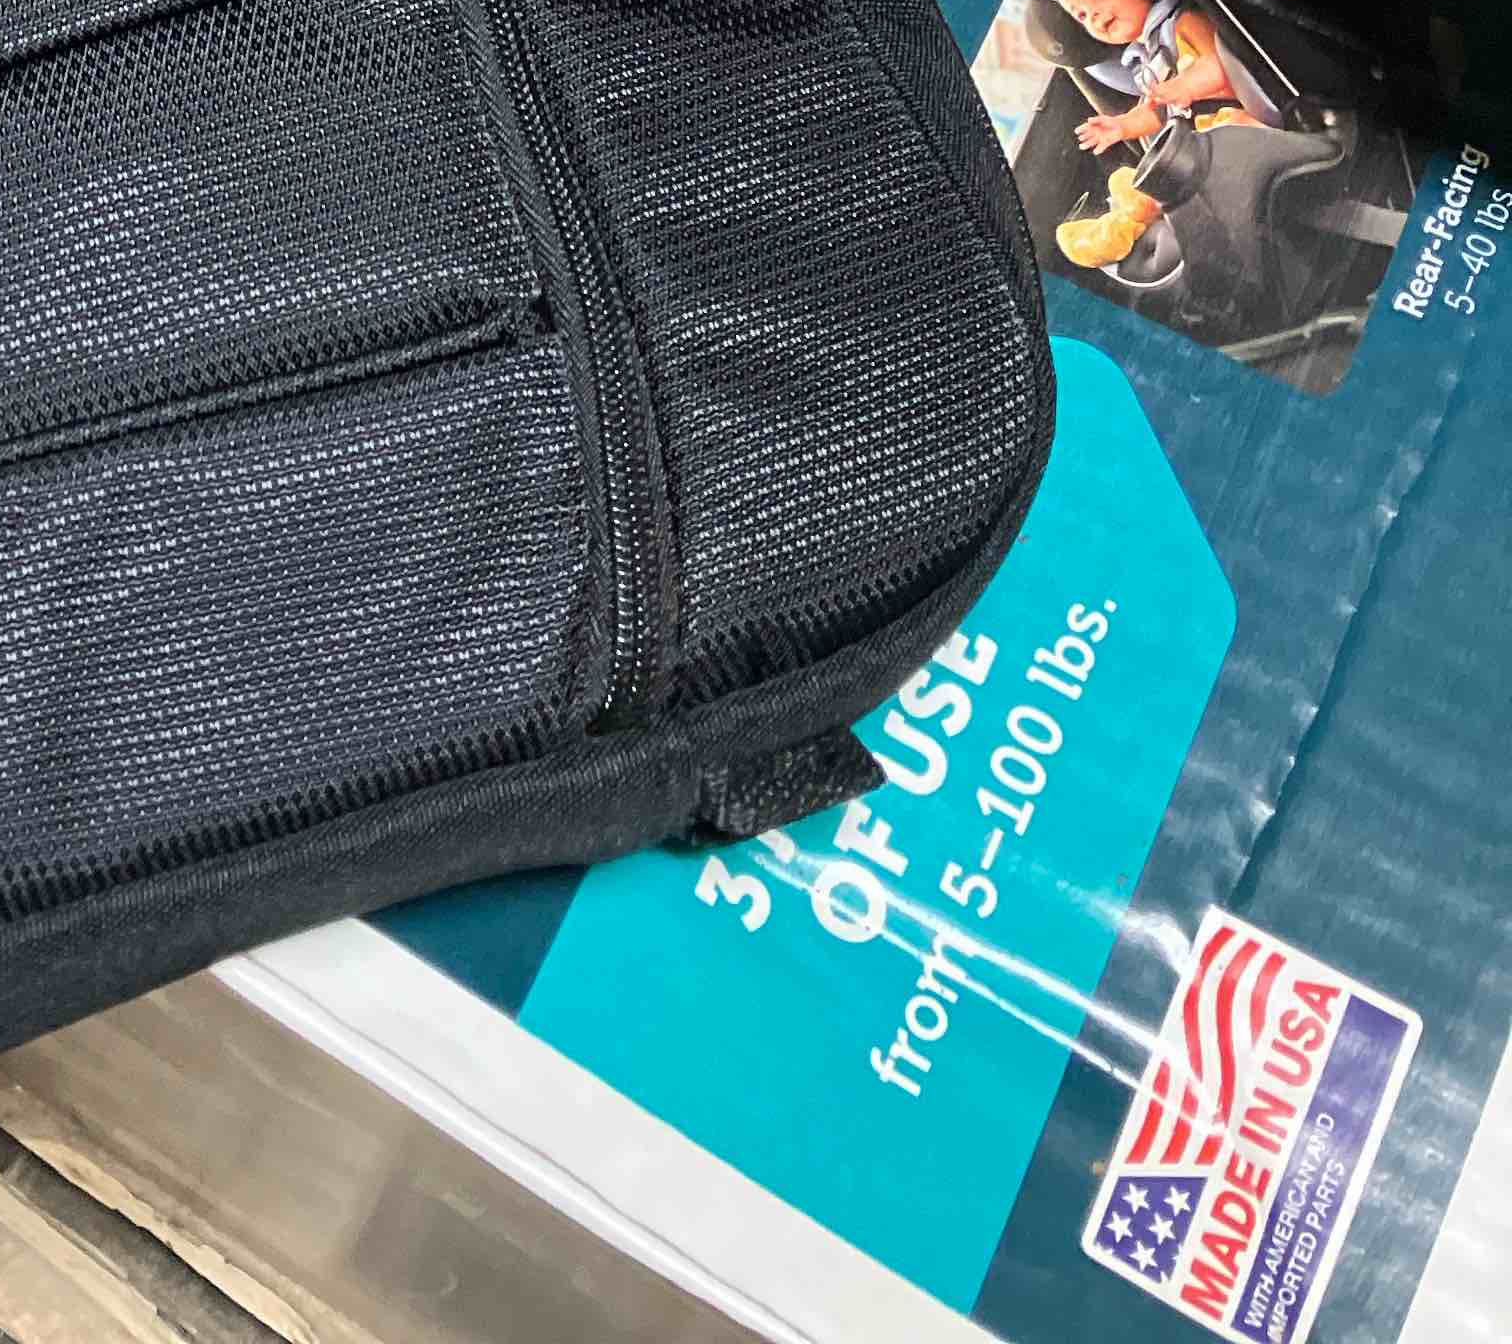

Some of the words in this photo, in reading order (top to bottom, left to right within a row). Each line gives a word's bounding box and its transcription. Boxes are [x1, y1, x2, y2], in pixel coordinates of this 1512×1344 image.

[1393, 143, 1489, 320] Rear-Facing
[875, 630, 999, 797] USE
[870, 924, 979, 1098] from
[1026, 598, 1119, 701] lbs.
[1238, 1086, 1299, 1155] IN
[1262, 980, 1342, 1087] USA
[1180, 1150, 1272, 1322] MADE
[1243, 1273, 1276, 1329] WITH
[1267, 1160, 1317, 1284] AMERICAN
[1305, 1112, 1336, 1168] AND
[1266, 1231, 1317, 1342] IMPORTED
[1305, 1158, 1346, 1231] PARTS
